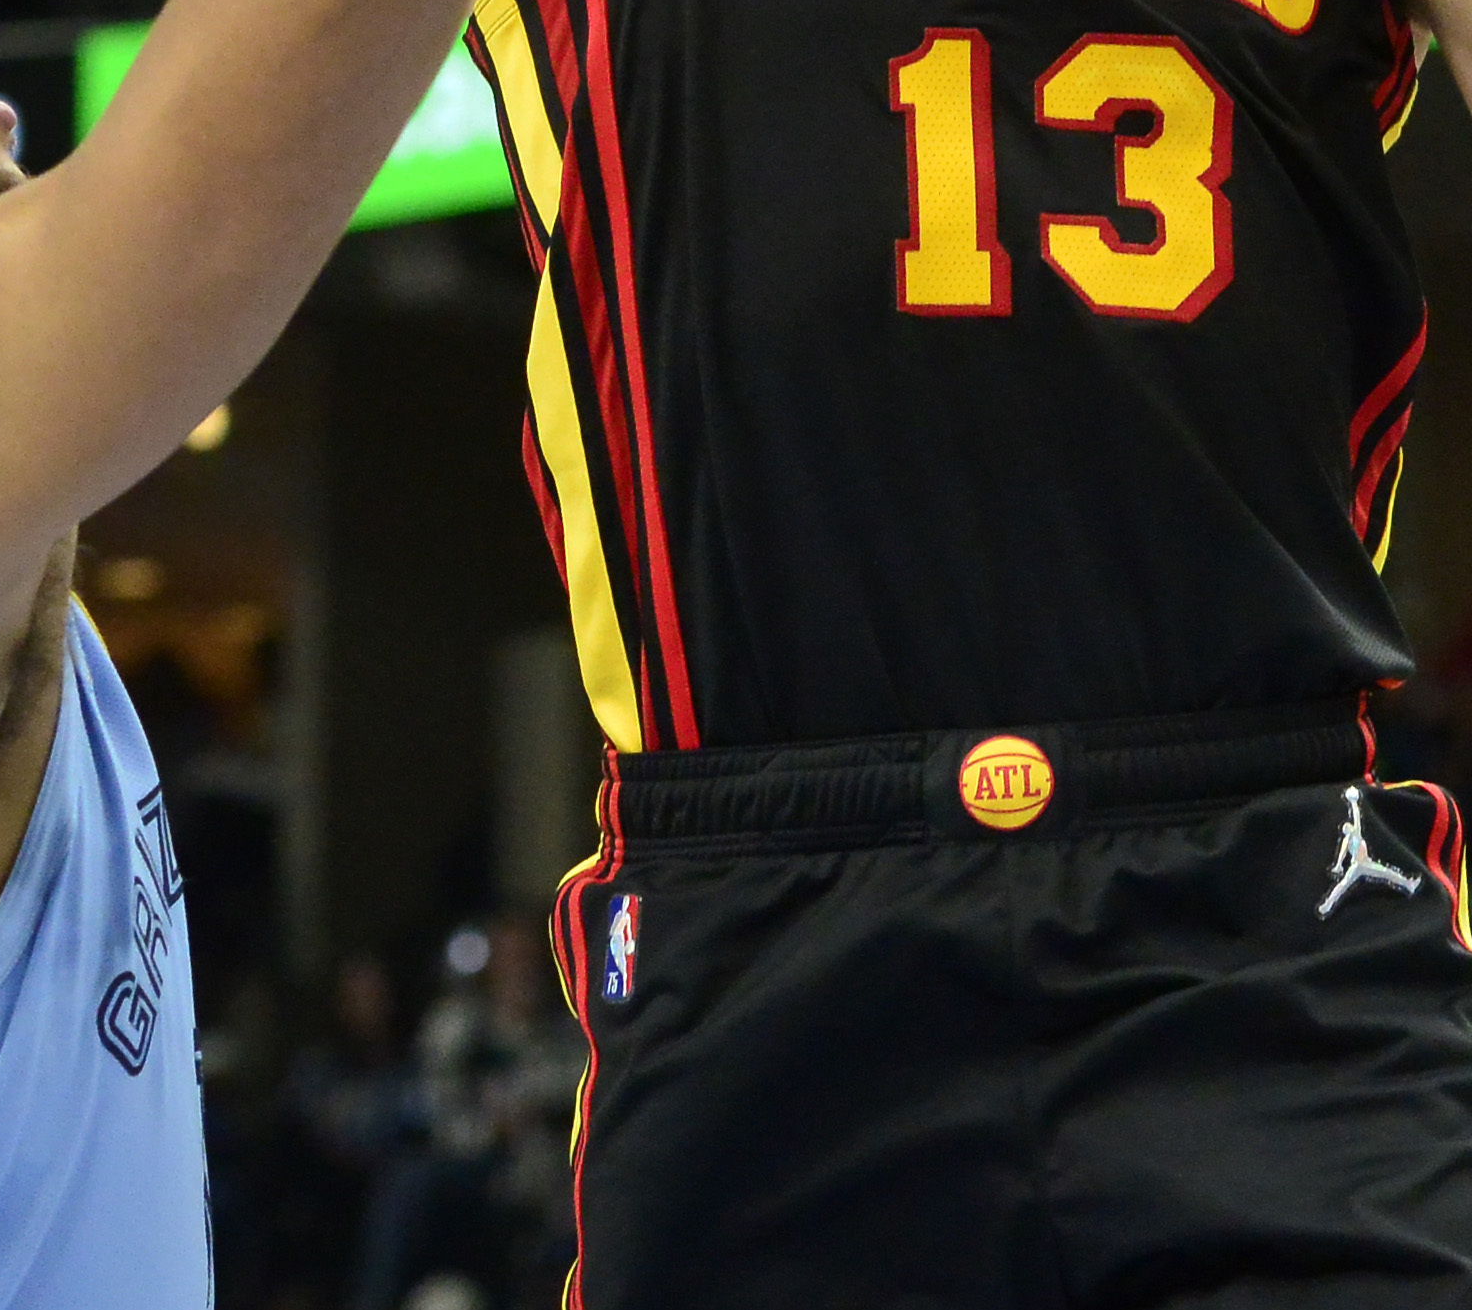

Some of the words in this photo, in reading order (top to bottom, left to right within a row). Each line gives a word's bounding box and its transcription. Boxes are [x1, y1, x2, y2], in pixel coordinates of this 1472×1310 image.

[888, 26, 1235, 324] 13
[974, 764, 1042, 801] ATL
[606, 971, 619, 995] 75
